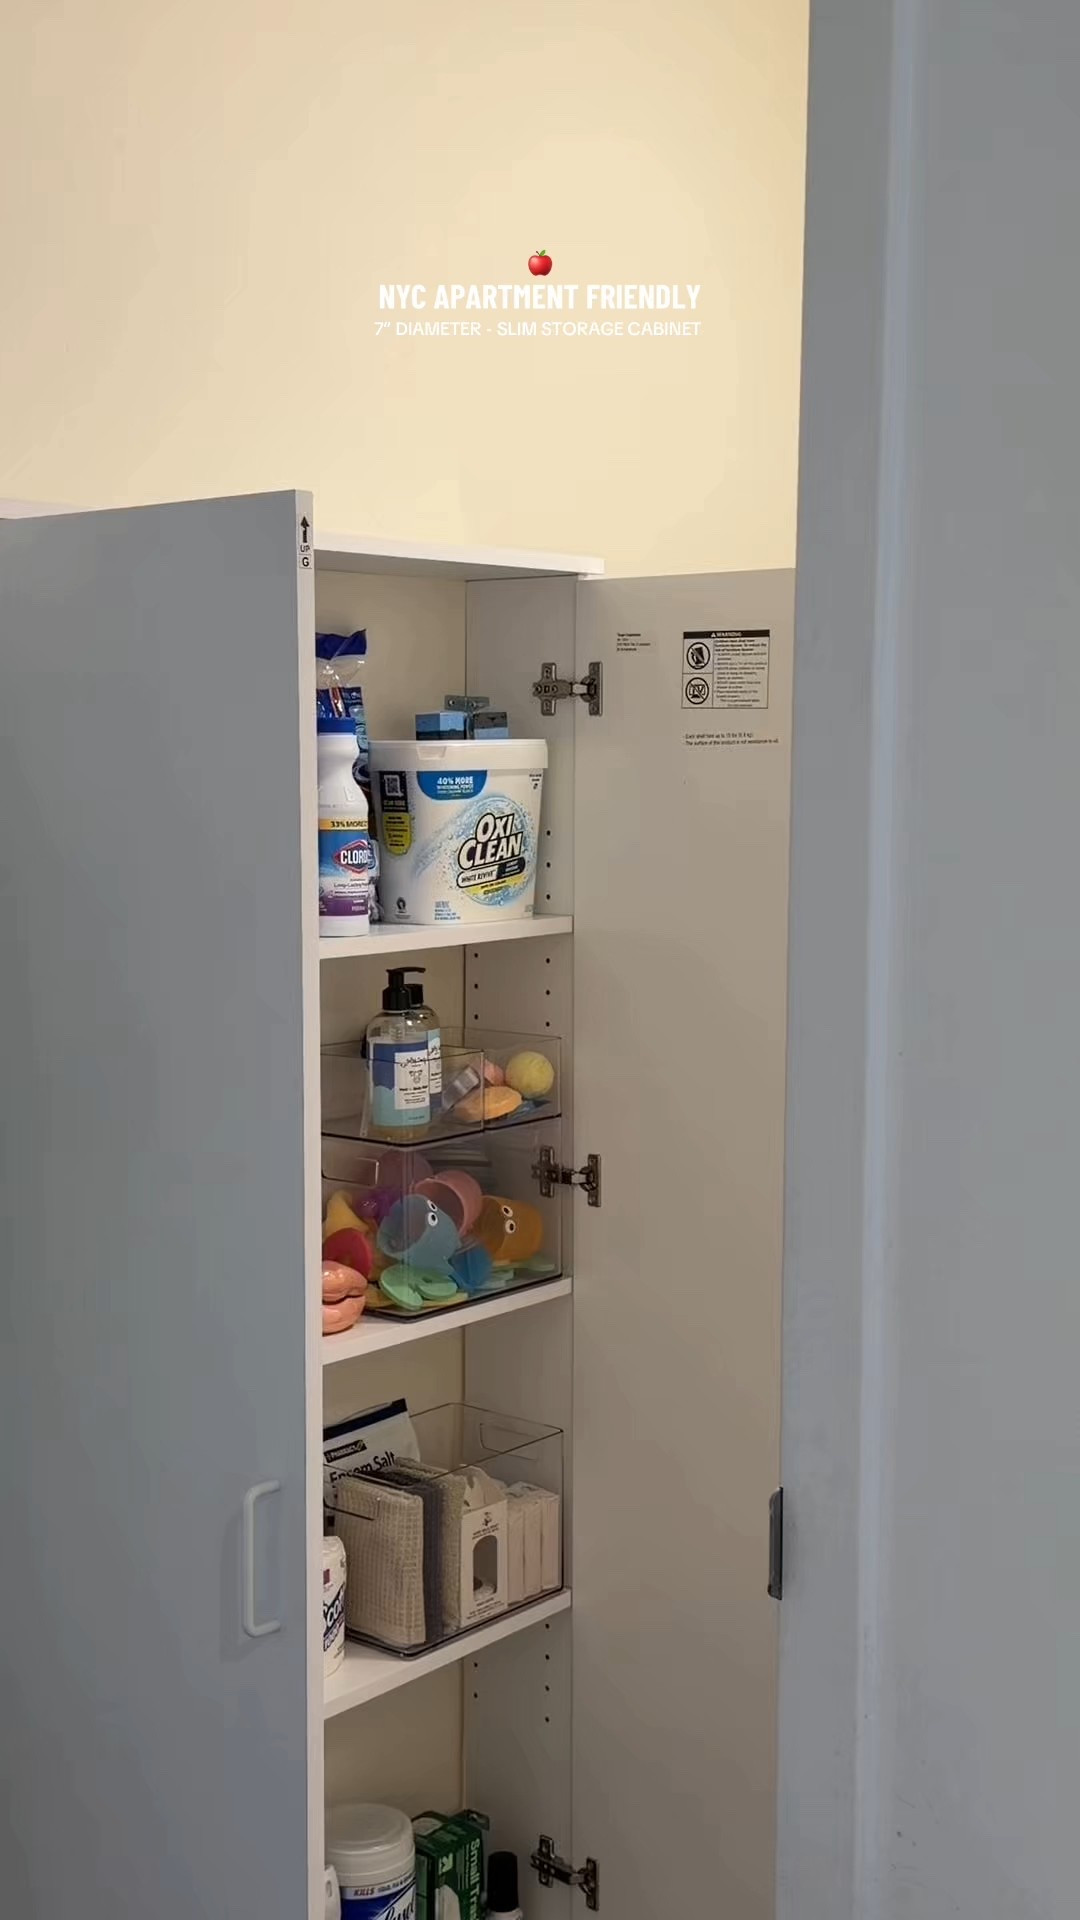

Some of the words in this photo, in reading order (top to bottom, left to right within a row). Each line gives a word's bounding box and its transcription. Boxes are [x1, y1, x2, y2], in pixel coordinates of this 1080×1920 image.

[302, 556, 310, 567] G
[437, 776, 454, 785] 40%
[454, 776, 474, 784] MORE
[475, 813, 514, 843] OXI
[458, 832, 523, 870] CLEAN
[373, 1451, 395, 1469] Salt
[470, 1838, 481, 1885] Small
